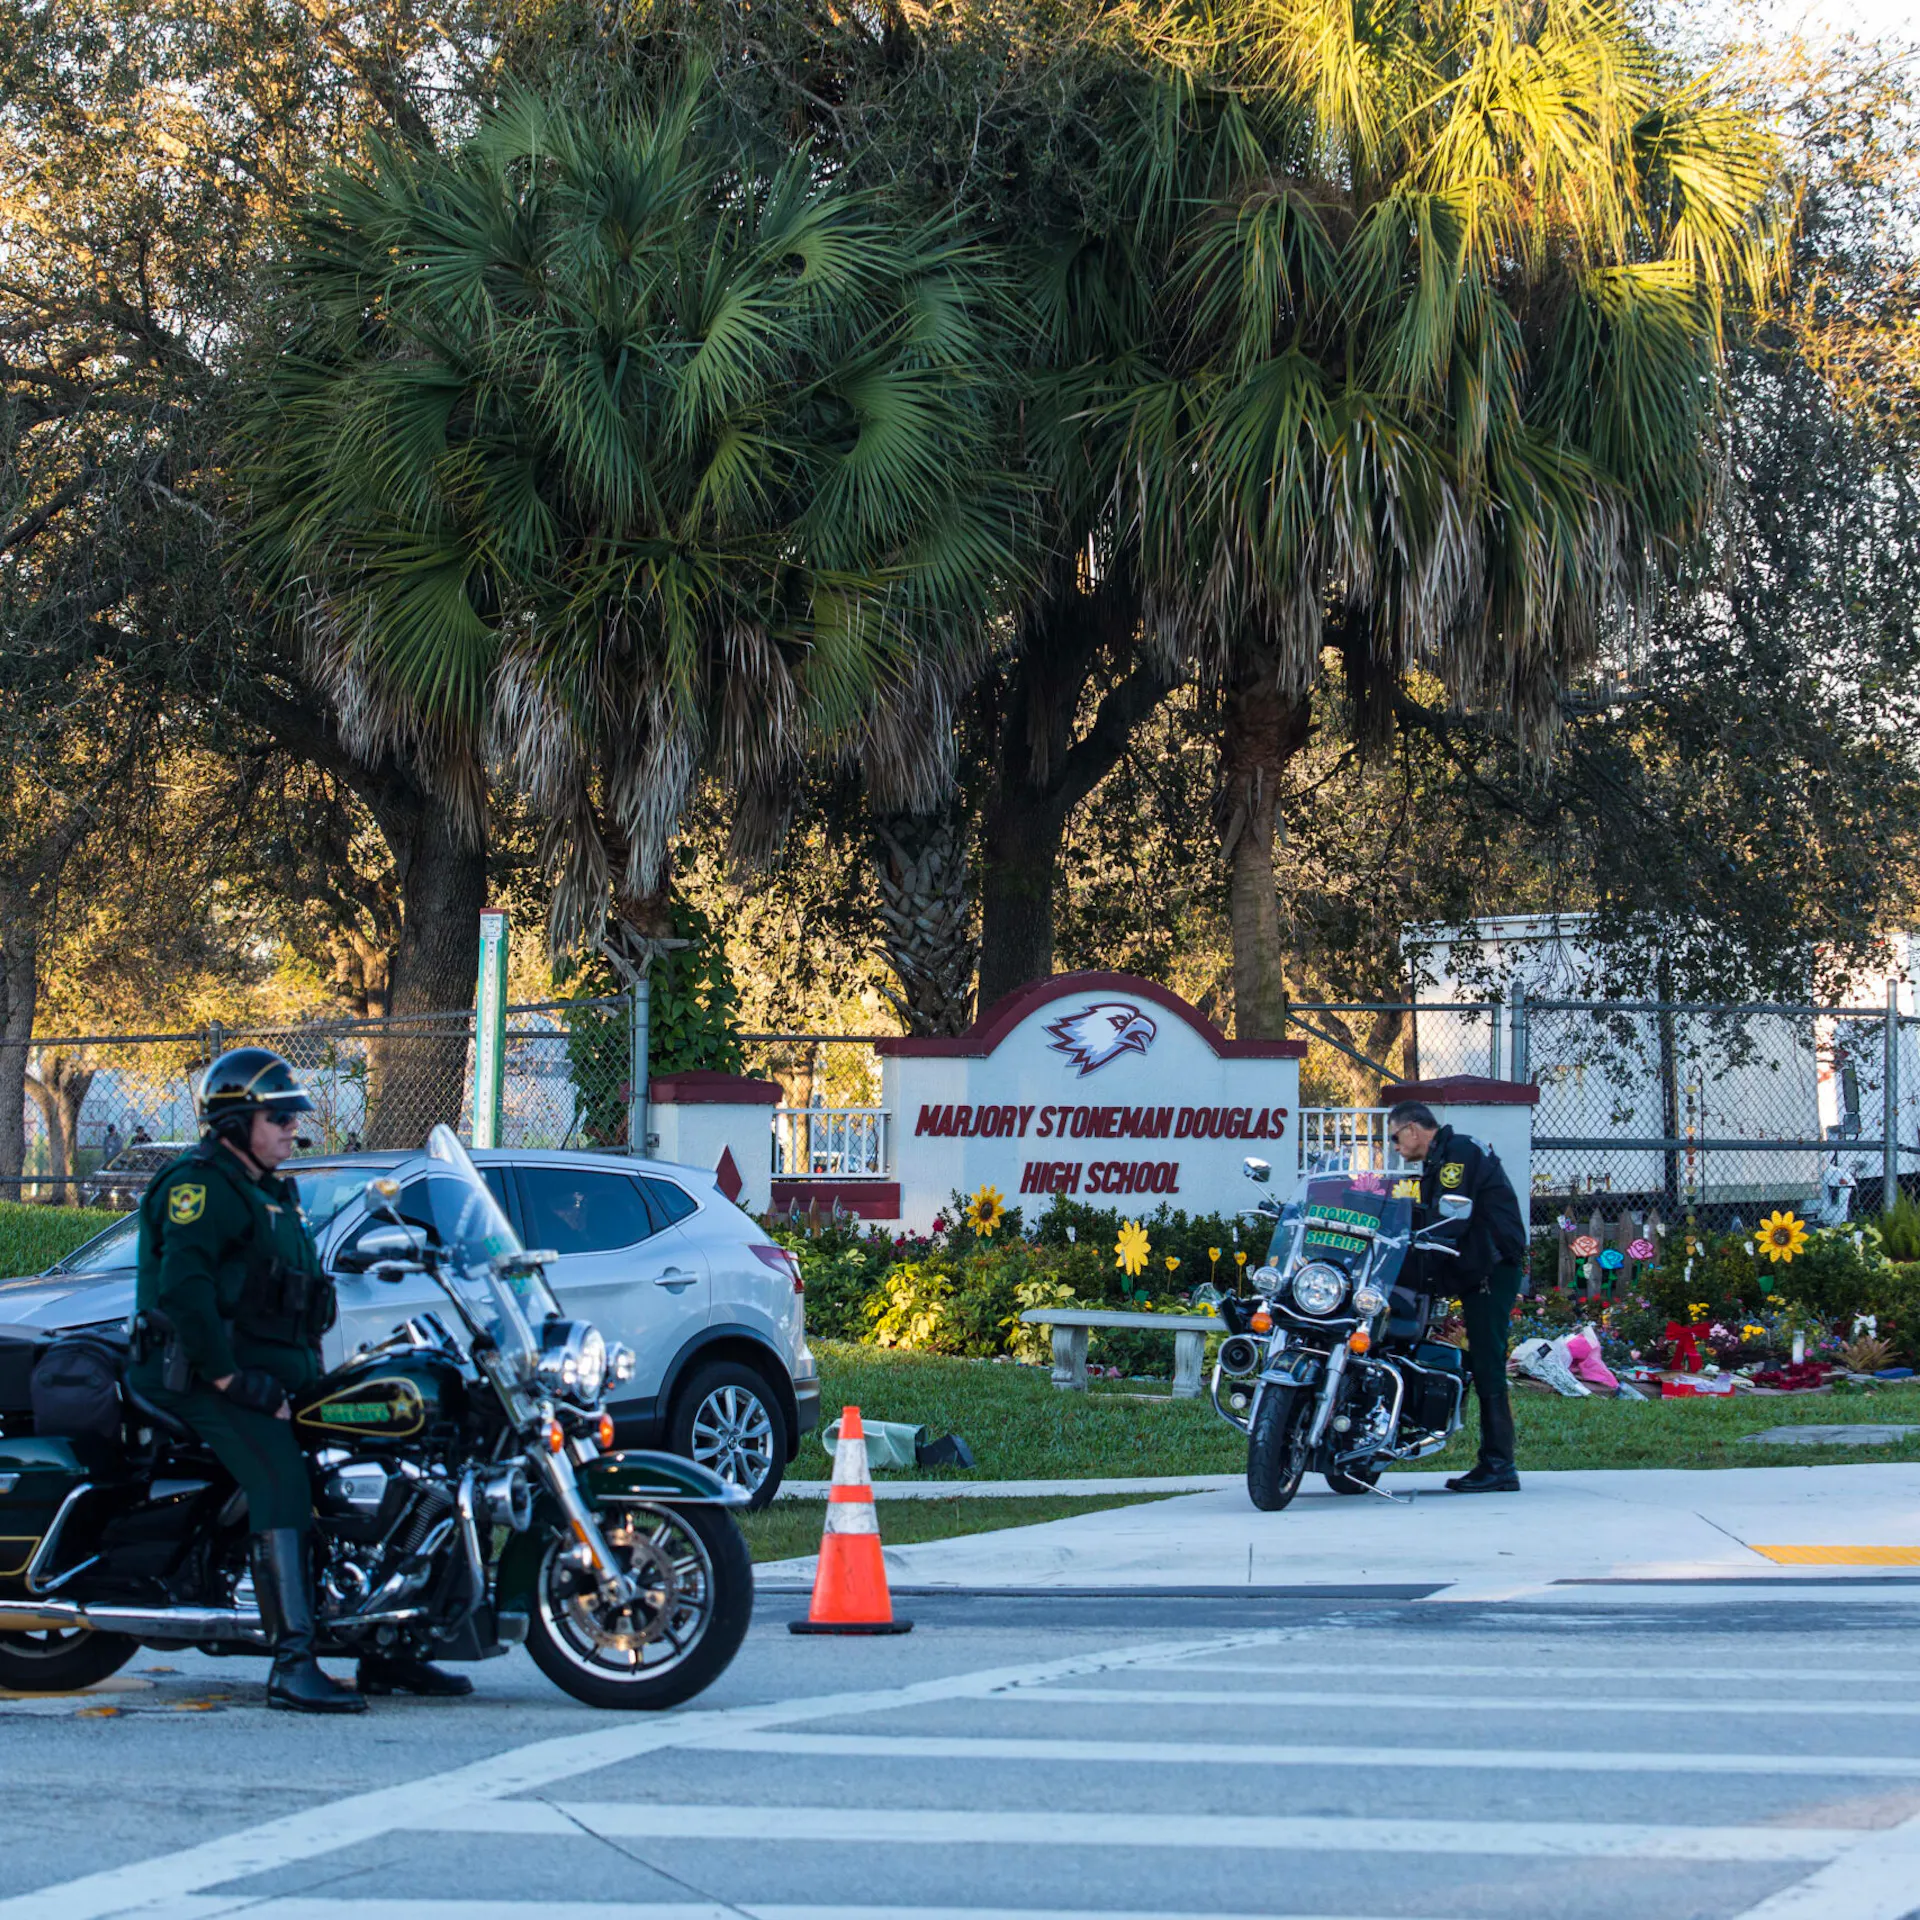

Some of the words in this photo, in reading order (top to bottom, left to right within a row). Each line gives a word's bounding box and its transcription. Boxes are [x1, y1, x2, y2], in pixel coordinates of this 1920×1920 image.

[915, 1105, 1035, 1137] MARJORY
[1037, 1106, 1174, 1138] STONEMAN
[1174, 1107, 1288, 1139] DOUGLAS
[1020, 1162, 1082, 1194] HIGH
[1085, 1162, 1179, 1194] SCHOOL
[1309, 1205, 1380, 1229] BROWARD
[1305, 1231, 1367, 1253] SHERIFF
